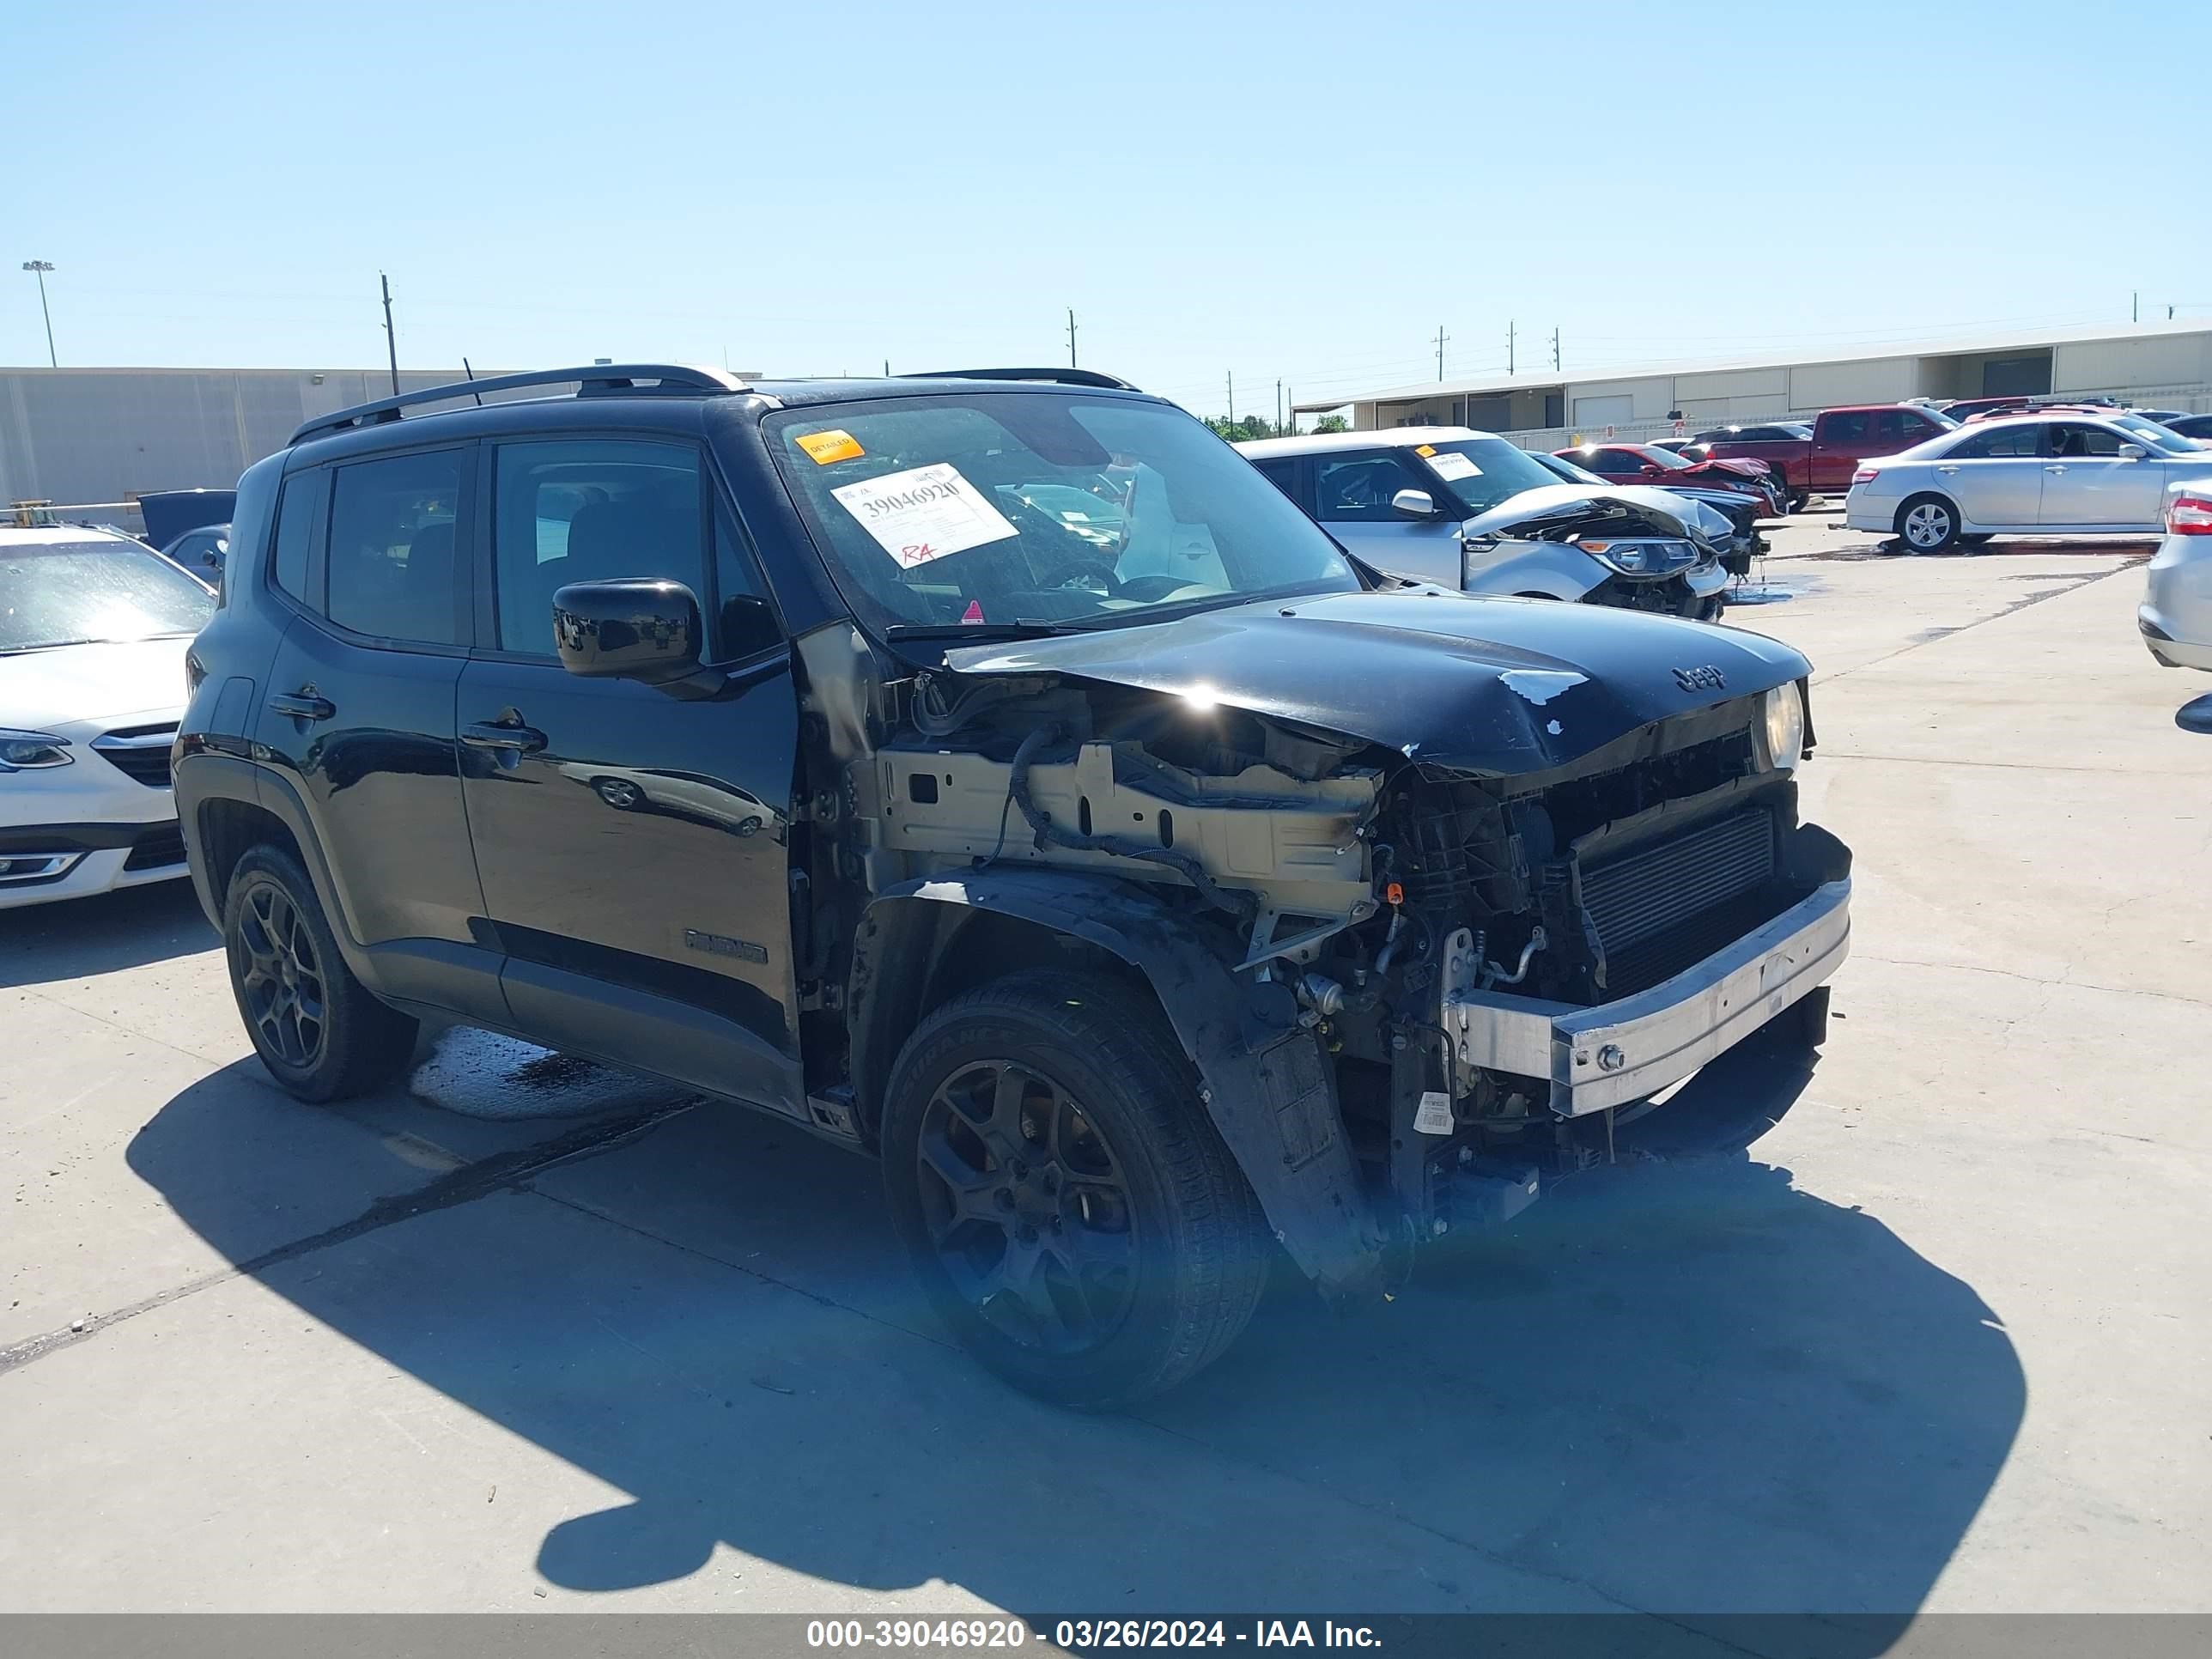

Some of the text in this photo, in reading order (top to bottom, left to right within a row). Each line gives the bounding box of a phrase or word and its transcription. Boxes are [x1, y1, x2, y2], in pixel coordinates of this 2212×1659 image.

[811, 439, 850, 453] DETAILED
[861, 481, 961, 519] 39046920
[1670, 665, 1727, 692] Jeep
